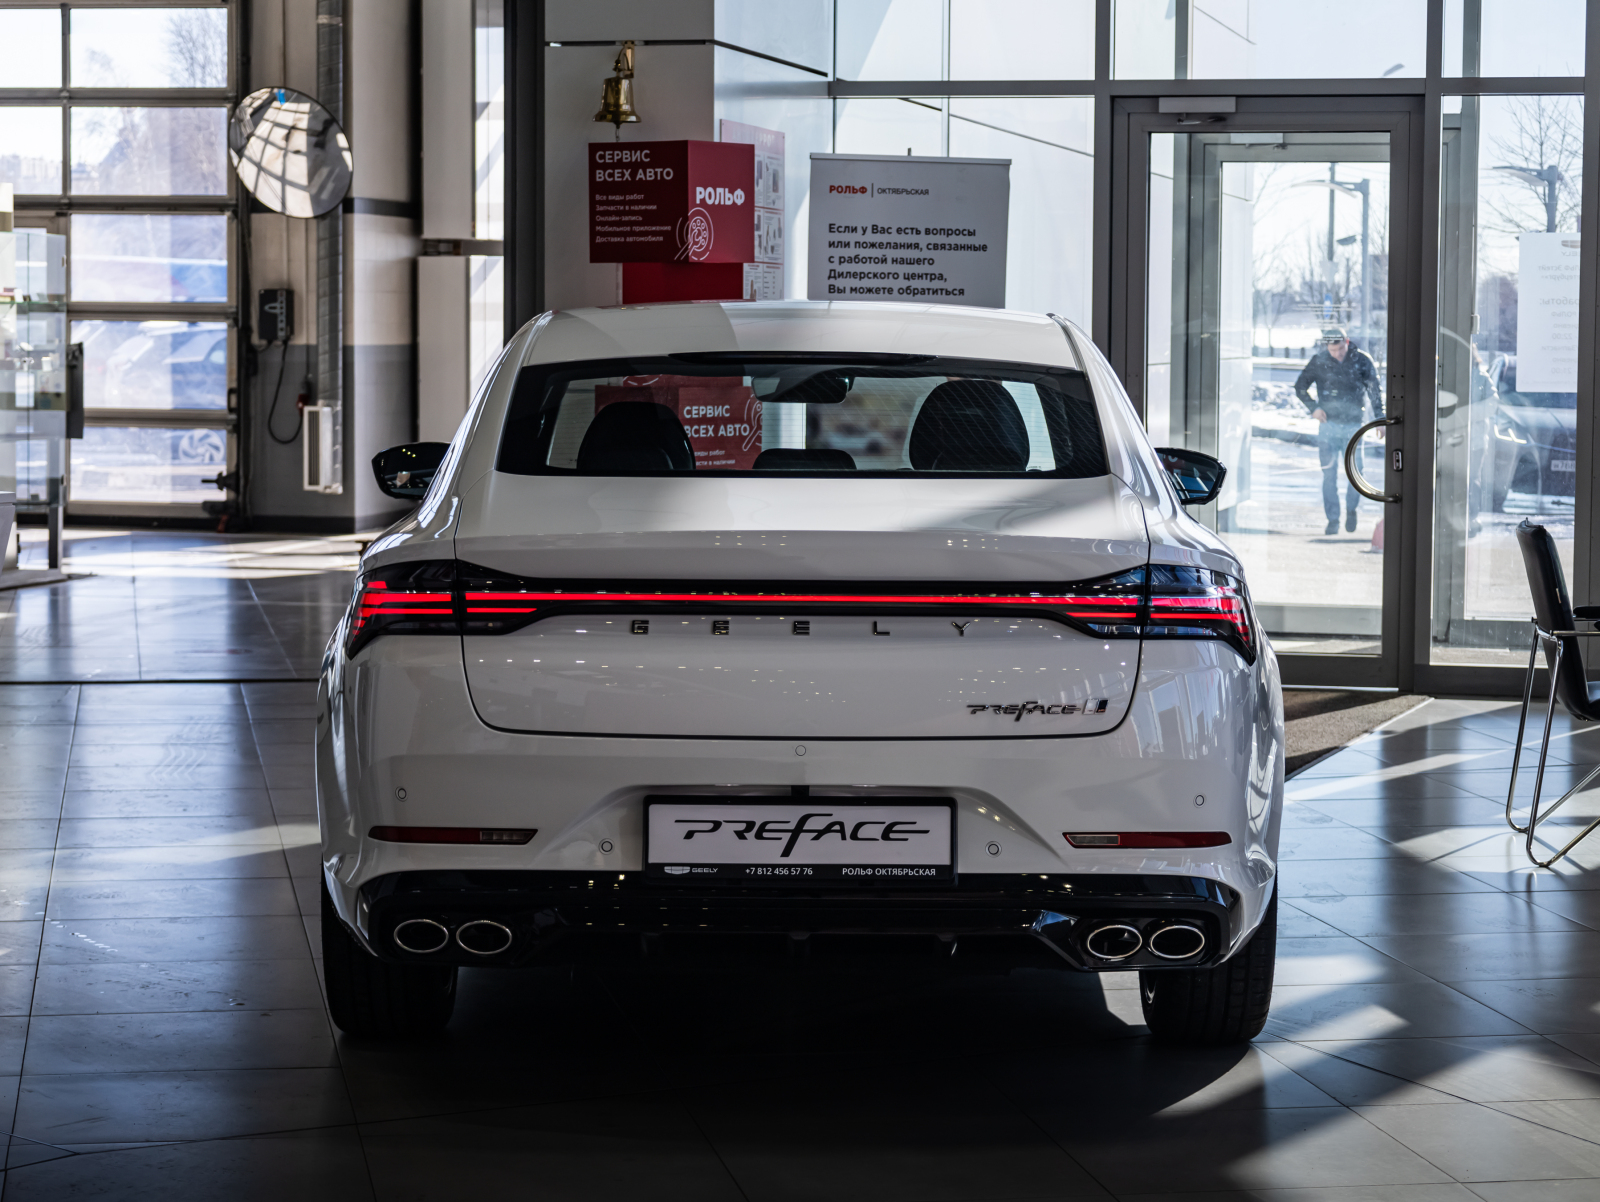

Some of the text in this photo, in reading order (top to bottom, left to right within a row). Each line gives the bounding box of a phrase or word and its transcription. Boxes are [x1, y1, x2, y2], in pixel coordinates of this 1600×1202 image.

[595, 150, 651, 163] СЕРВИС
[595, 168, 674, 182] ВСЕХ АВТО
[695, 186, 745, 206] РОЛЬФ
[829, 185, 868, 195] РОЛЬФ
[877, 187, 930, 196] ОКТЯБРЬСКАЯ
[625, 193, 645, 201] работ
[595, 214, 643, 222] Онлайн-запись
[632, 225, 671, 233] приложение
[828, 223, 976, 238] Если у Вас есть вопросы
[595, 235, 625, 243] Доставка
[828, 239, 988, 252] или пожелания, связанные
[828, 254, 935, 266] с работой нашего
[827, 269, 947, 283] Дилерского центра,
[828, 284, 965, 297] Вы можете обратиться
[683, 405, 730, 419] СЕРВИС
[718, 423, 750, 437] АВТО
[709, 449, 725, 457] работ
[632, 619, 971, 636] GEELY
[966, 701, 1081, 722] PREFACE
[674, 813, 930, 858] PREFACE
[745, 867, 813, 876] +7 812 456 57 76
[842, 868, 936, 877] РОЛЬФ ОКТЯБРЬСКАЯ
